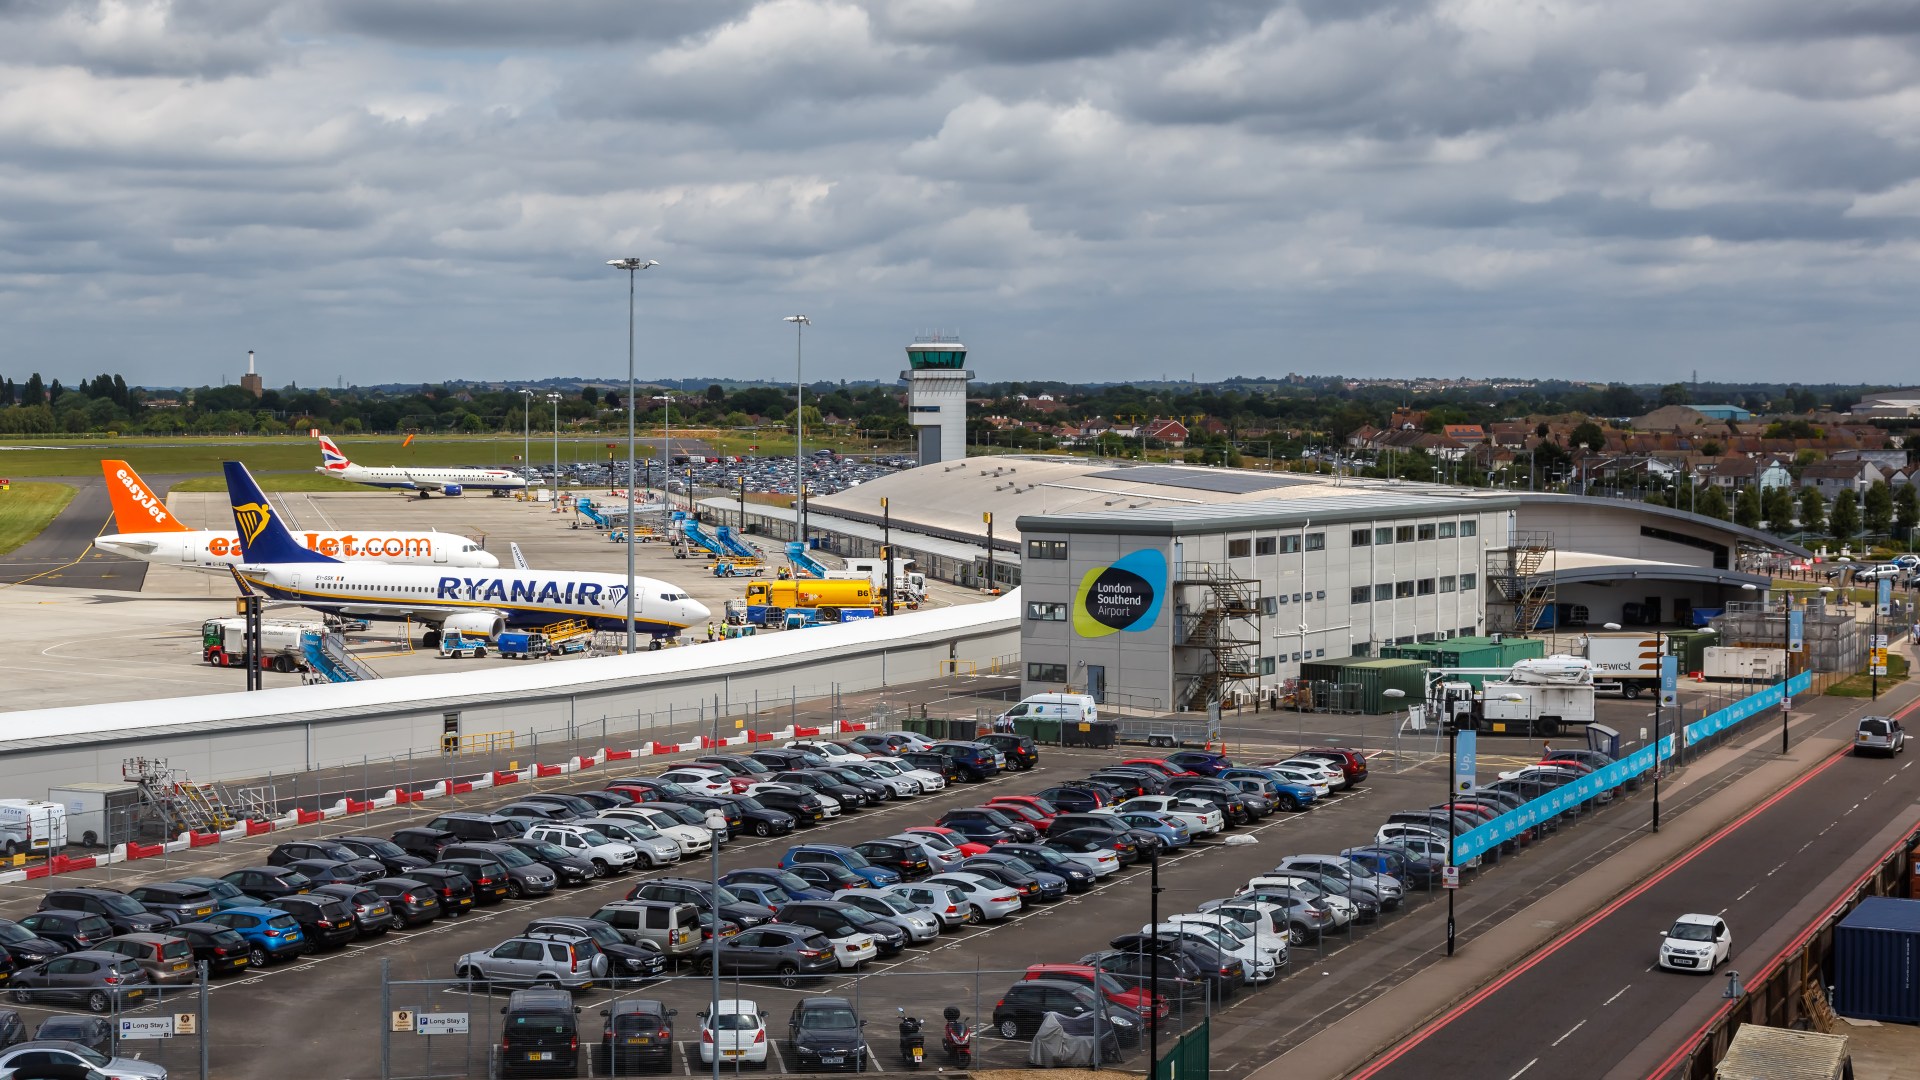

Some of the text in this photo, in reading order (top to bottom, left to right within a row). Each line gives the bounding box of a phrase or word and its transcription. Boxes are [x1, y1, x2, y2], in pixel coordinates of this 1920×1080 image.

[116, 469, 167, 524] easyJet
[209, 533, 432, 557] eaJet.com
[231, 567, 251, 594] RYANAIR
[1097, 582, 1132, 594] London
[437, 576, 603, 606] RYANAIR
[1097, 594, 1141, 605] Southend
[1098, 606, 1130, 618] Airport
[1596, 661, 1631, 671] newrest
[1460, 753, 1472, 771] Up,
